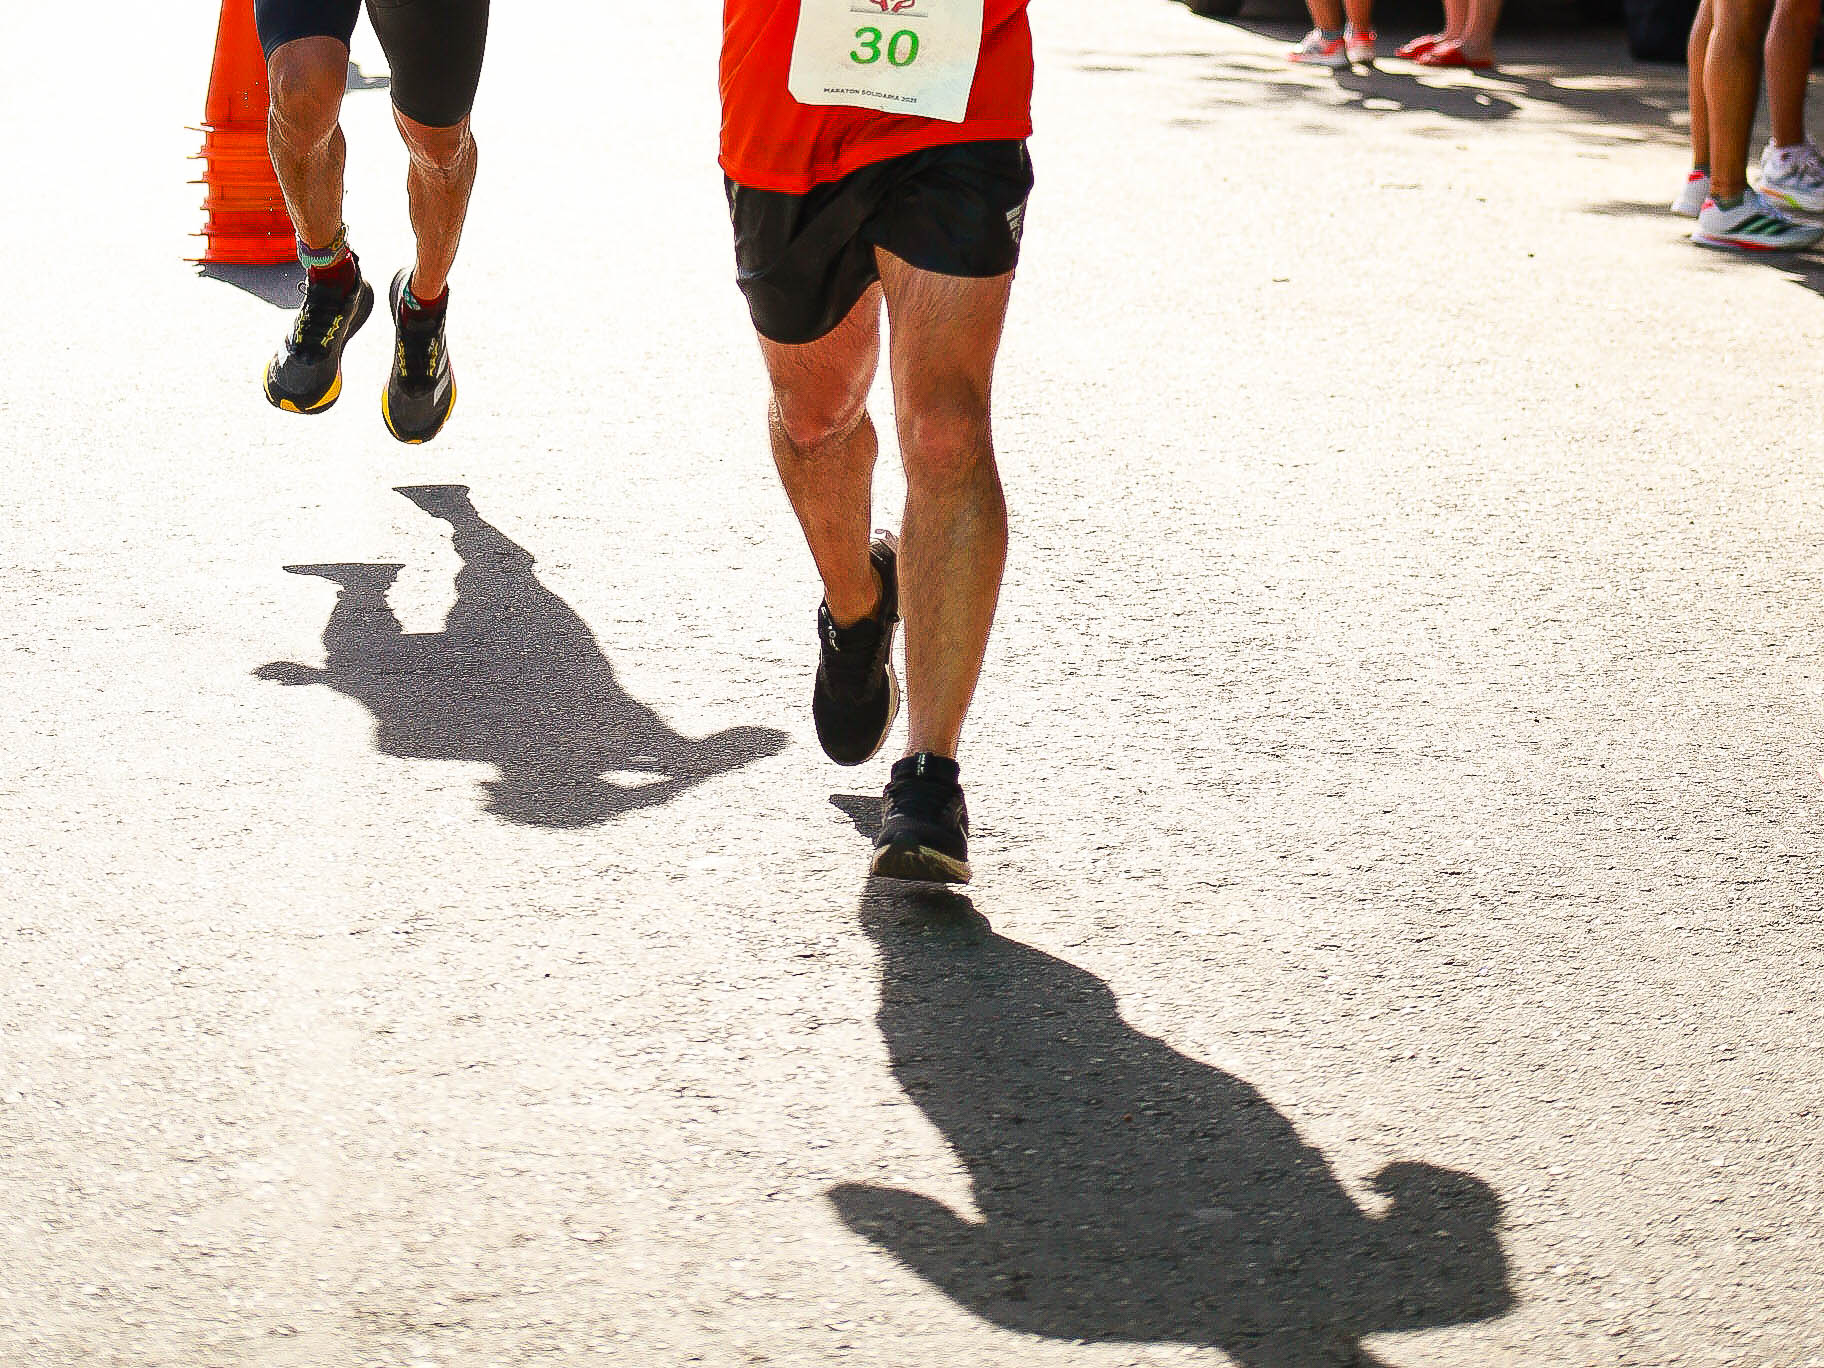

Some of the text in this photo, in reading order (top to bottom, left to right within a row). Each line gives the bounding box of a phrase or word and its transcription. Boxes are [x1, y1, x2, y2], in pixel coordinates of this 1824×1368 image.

[849, 26, 920, 68] 30
[823, 87, 860, 95] MARATON
[861, 89, 899, 102] SOLIDARIA
